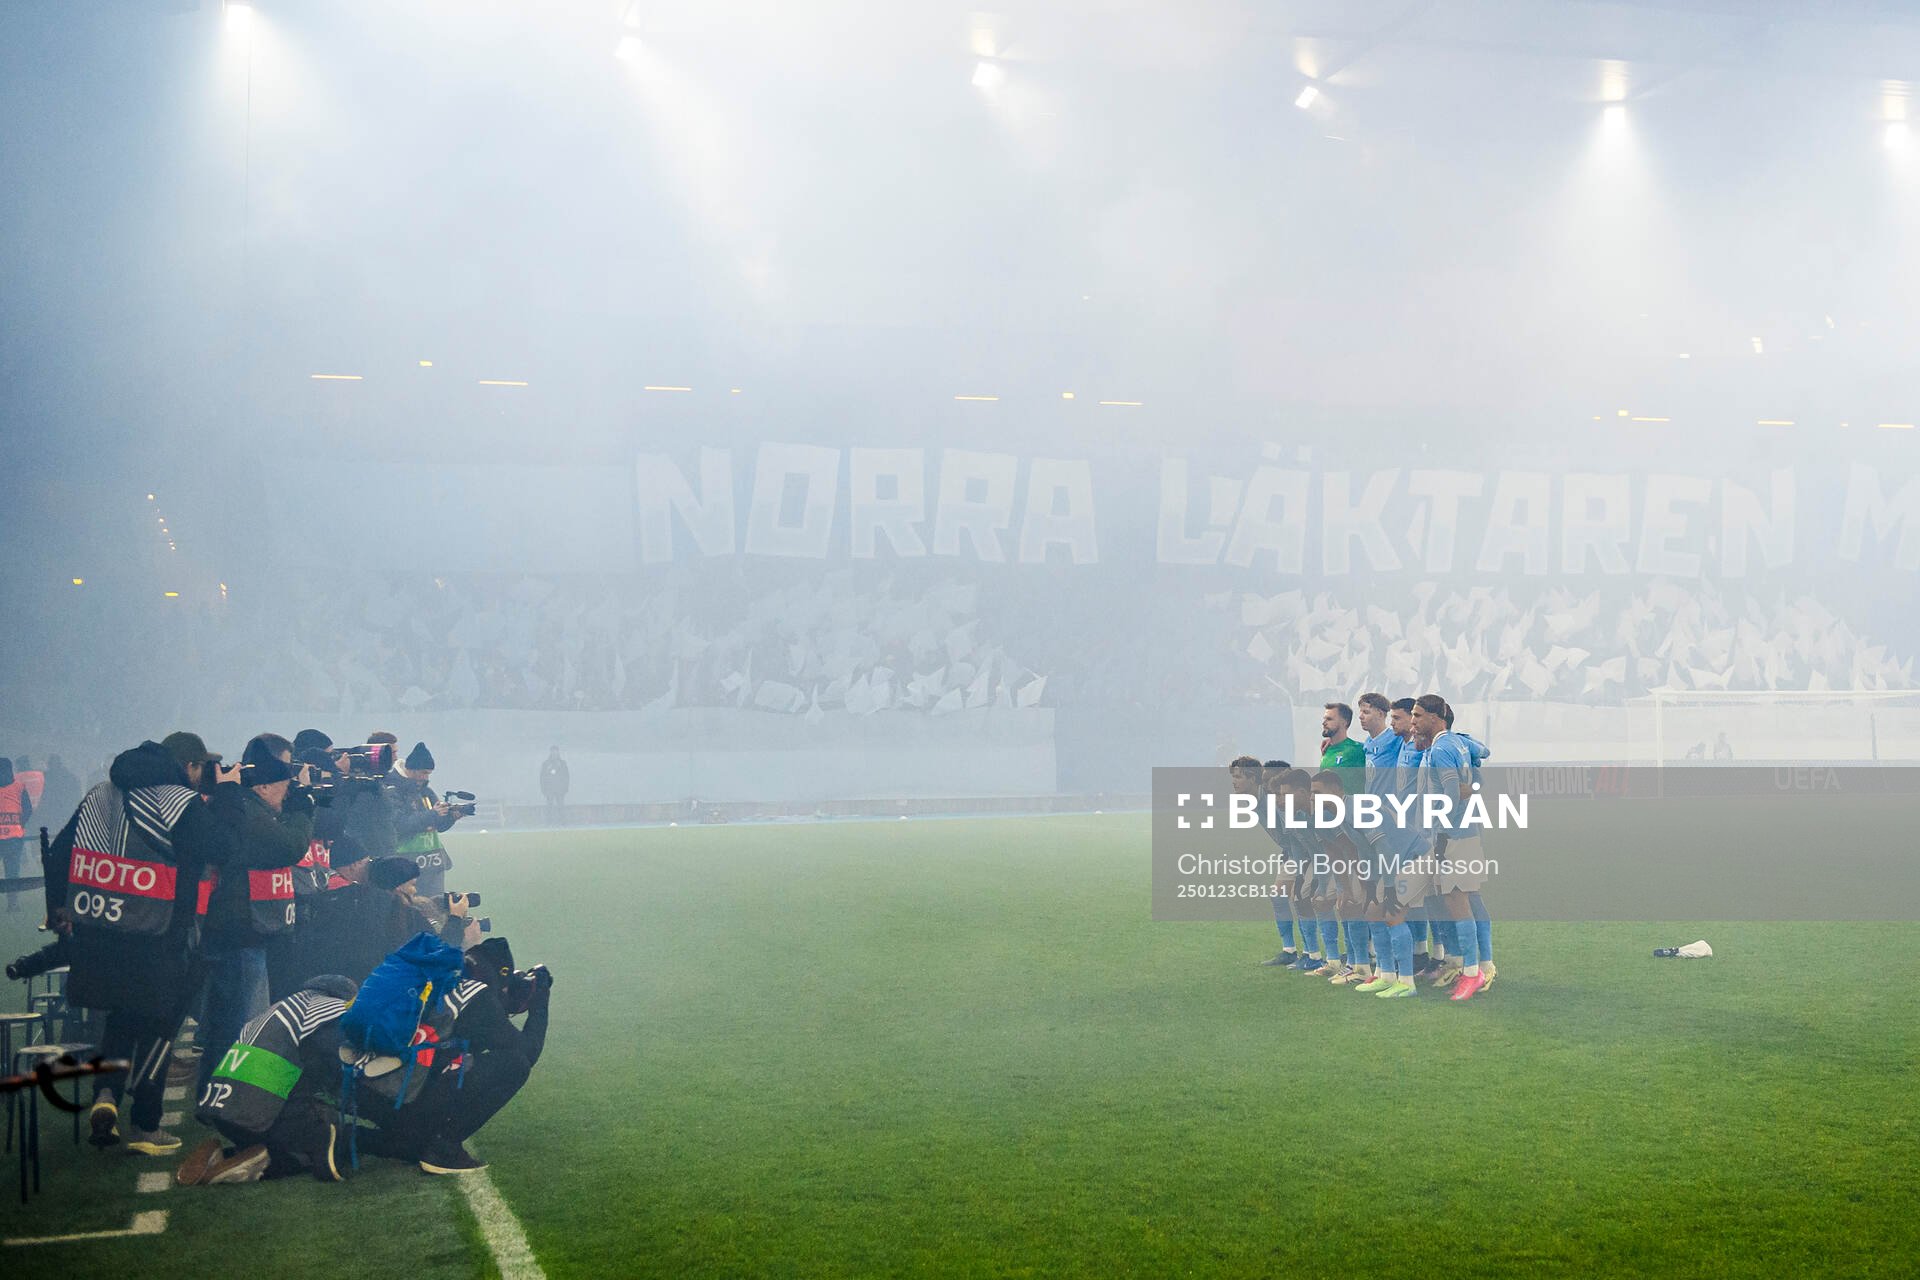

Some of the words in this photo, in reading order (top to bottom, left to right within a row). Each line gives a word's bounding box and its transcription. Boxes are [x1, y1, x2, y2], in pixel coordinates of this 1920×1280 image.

[637, 441, 1099, 565] NORRA
[1157, 441, 1796, 577] LÄKTAREN
[1506, 766, 1593, 796] WELCOME
[1774, 766, 1842, 790] UEFA
[74, 891, 125, 922] 093
